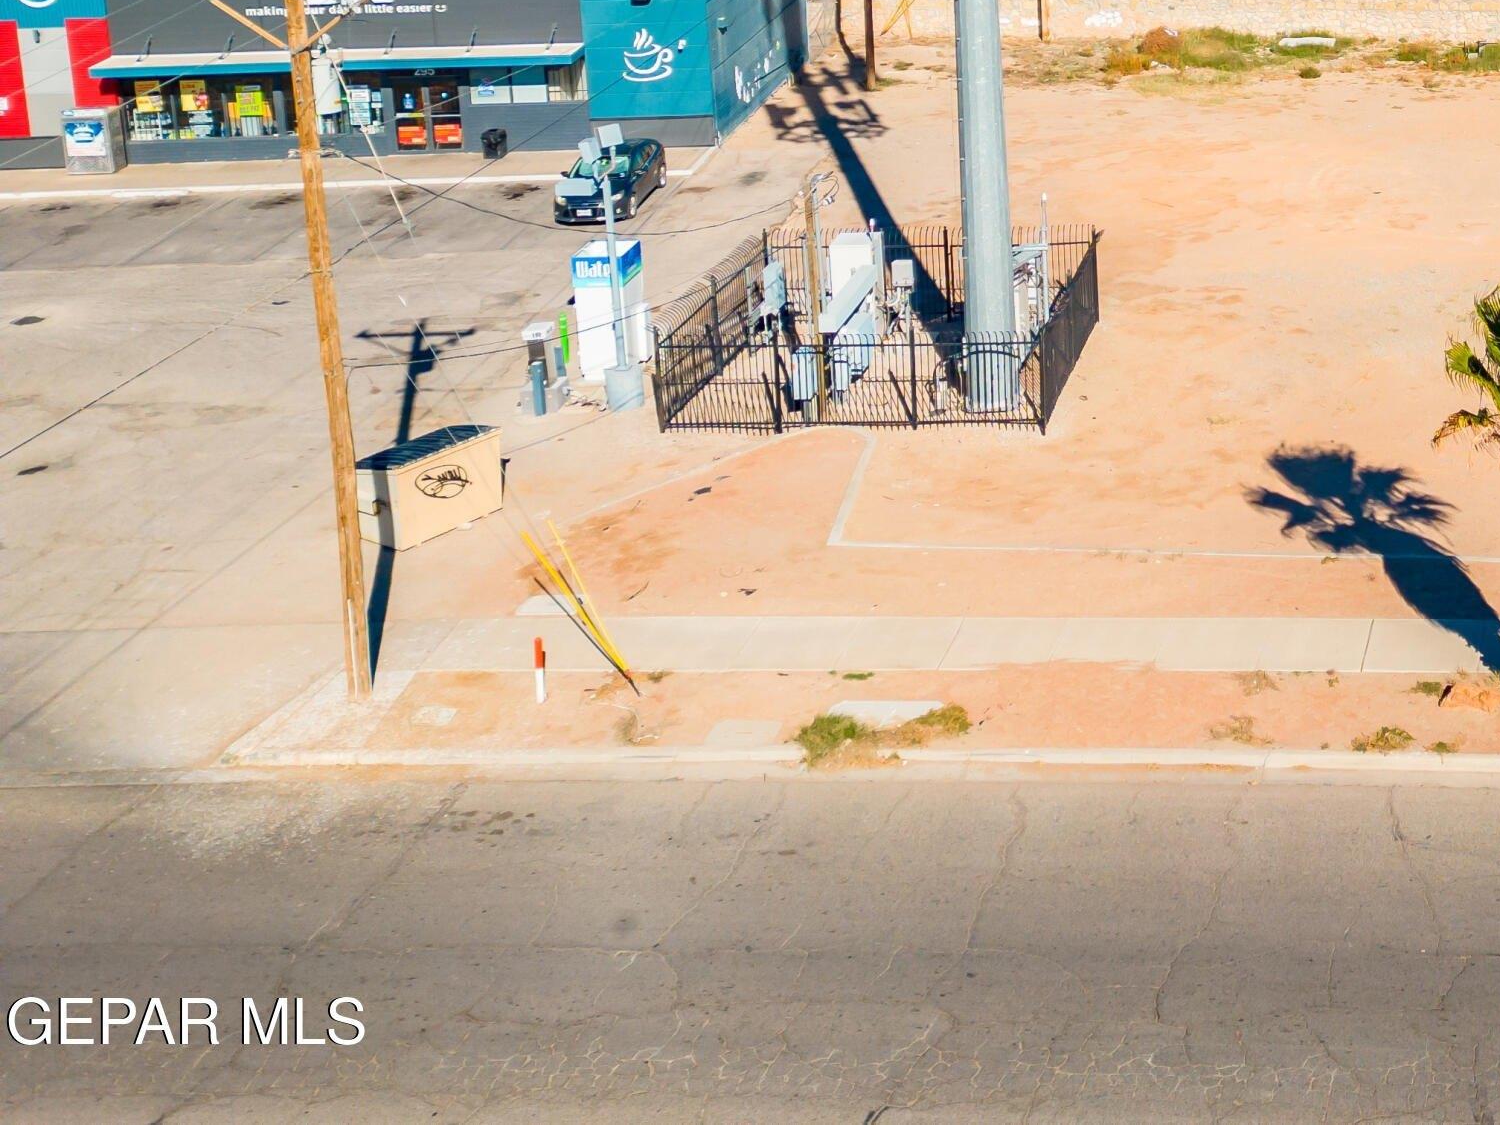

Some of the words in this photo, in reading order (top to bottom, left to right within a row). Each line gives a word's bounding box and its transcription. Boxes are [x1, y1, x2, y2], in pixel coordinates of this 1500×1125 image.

[364, 4, 393, 15] little
[396, 3, 433, 14] easier
[575, 260, 613, 279] Wate
